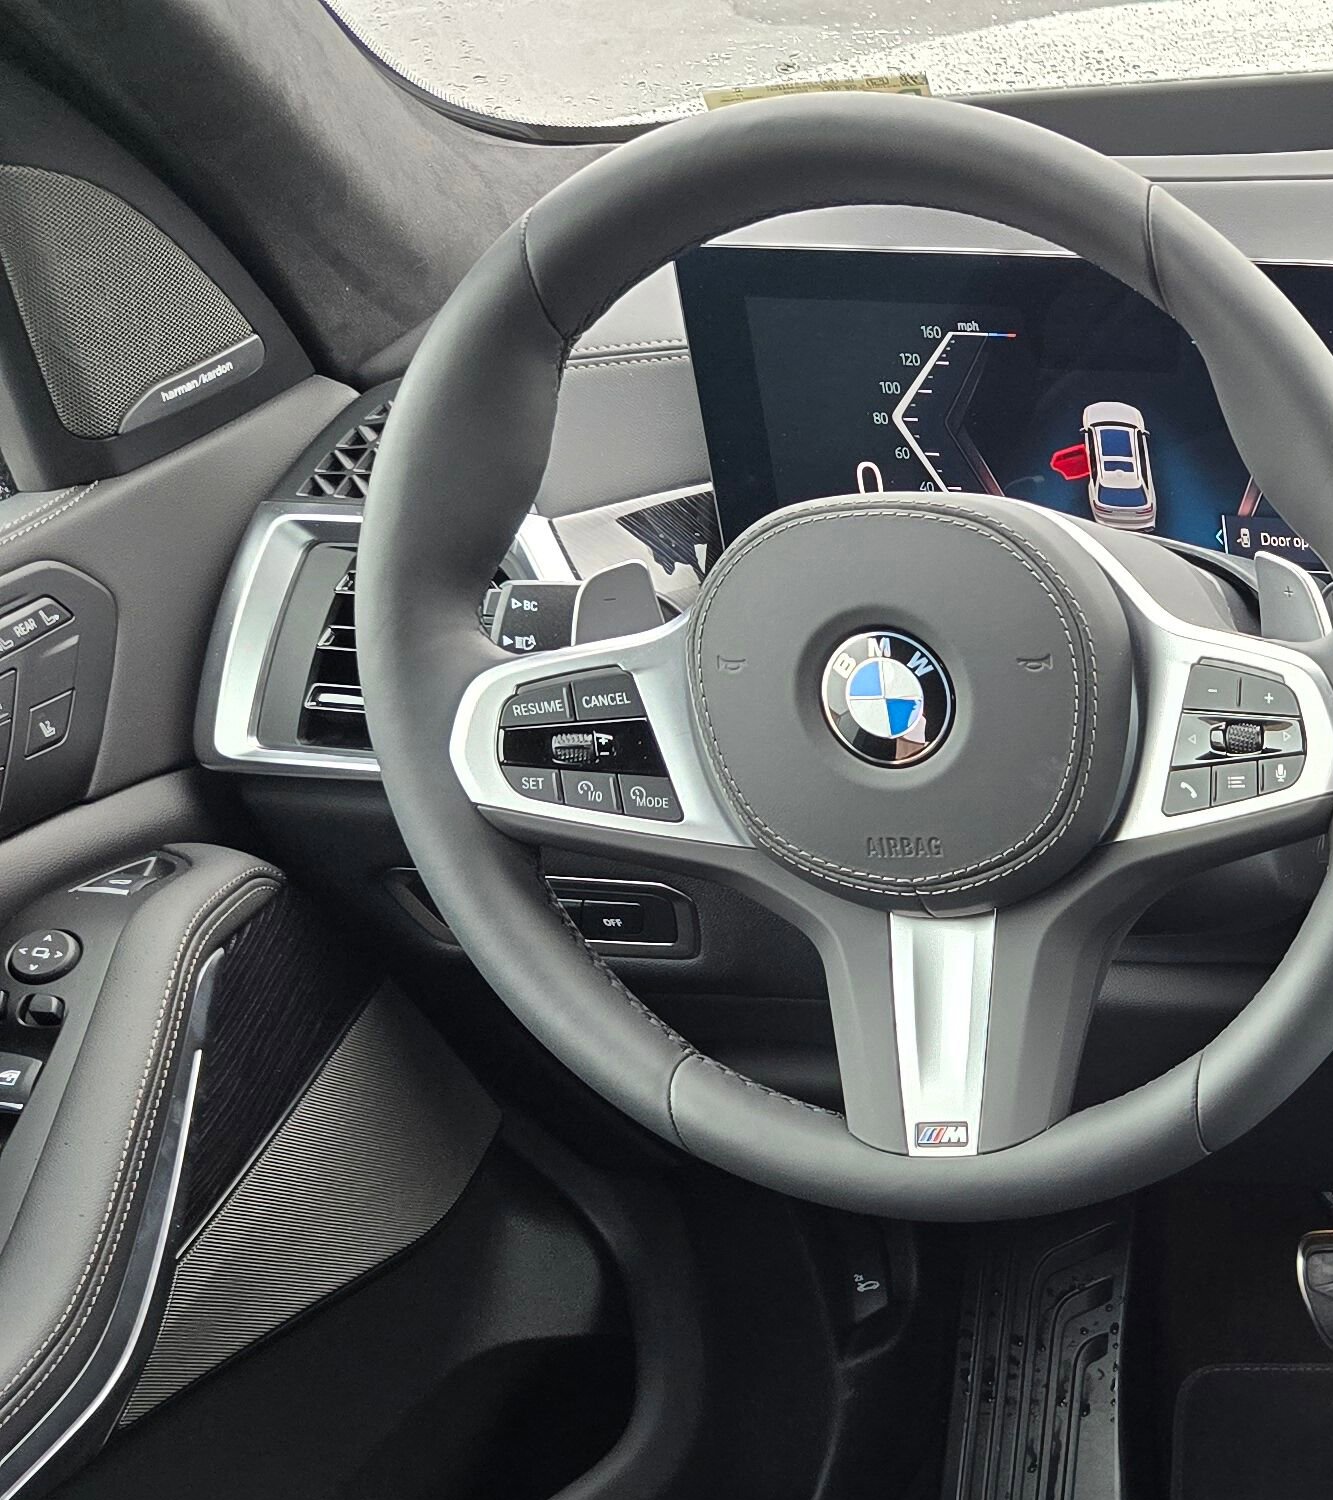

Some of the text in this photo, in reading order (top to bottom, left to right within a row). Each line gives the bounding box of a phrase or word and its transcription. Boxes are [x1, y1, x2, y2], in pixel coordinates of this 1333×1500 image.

[920, 325, 941, 339] 160
[958, 321, 979, 332] mph
[900, 353, 920, 366] 120
[161, 361, 233, 402] harman/kardon
[879, 381, 900, 394] 100
[873, 412, 888, 425] 80
[895, 447, 910, 459] 60
[920, 482, 934, 492] 40
[1261, 533, 1309, 550] Door op
[523, 600, 538, 612] BC
[13, 618, 37, 637] REAR
[833, 637, 934, 679] BMW
[582, 692, 631, 708] CANCEL
[512, 700, 564, 716] RESUME
[522, 778, 544, 789] SET
[636, 797, 669, 808] MODE
[867, 836, 944, 858] AIRBAG
[603, 918, 622, 927] OFF
